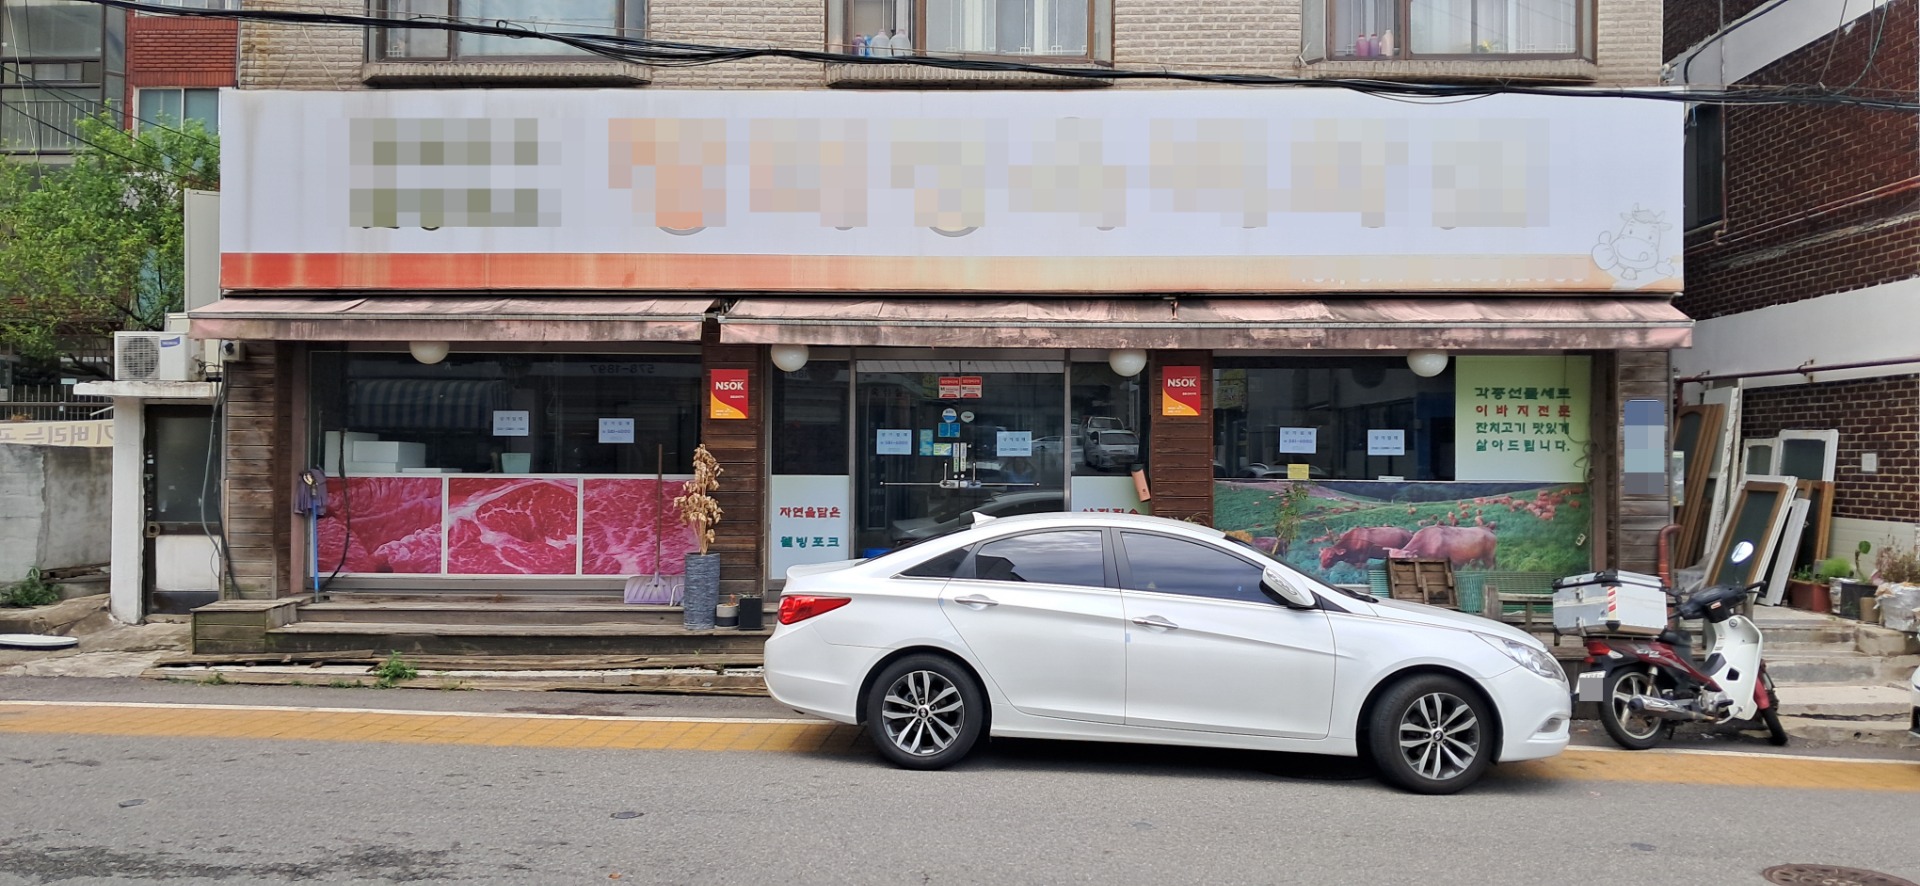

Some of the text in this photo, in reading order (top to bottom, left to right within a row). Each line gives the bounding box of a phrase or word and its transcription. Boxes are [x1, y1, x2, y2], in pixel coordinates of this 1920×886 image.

[715, 381, 745, 390] NSOK
[1167, 378, 1197, 387] NSOK
[1474, 387, 1572, 400] 각종선물세트
[1475, 422, 1570, 435] 잔치고기 맛있게
[779, 506, 841, 518] 자연을담은
